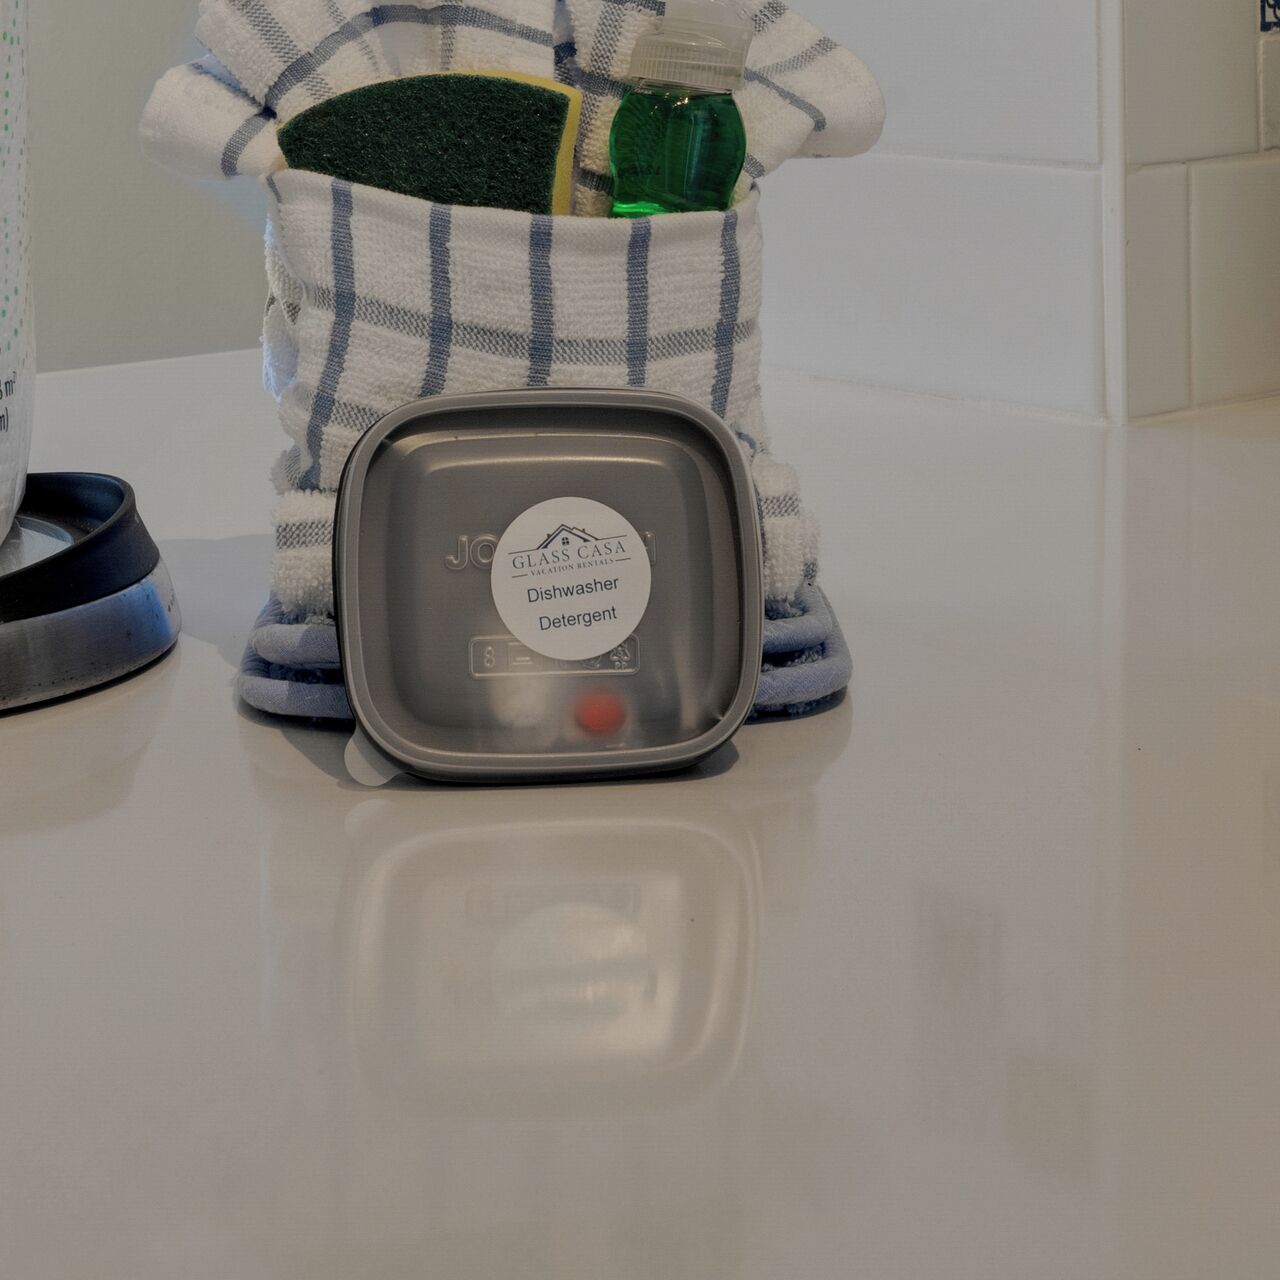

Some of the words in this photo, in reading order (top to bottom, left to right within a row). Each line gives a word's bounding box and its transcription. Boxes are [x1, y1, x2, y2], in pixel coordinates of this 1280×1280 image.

[512, 548, 570, 570] GLASS
[577, 540, 626, 560] CASA
[530, 564, 574, 577] VACATION
[577, 557, 614, 569] RENTALS
[527, 577, 619, 603] Dishwasher
[538, 606, 617, 631] Detergent
